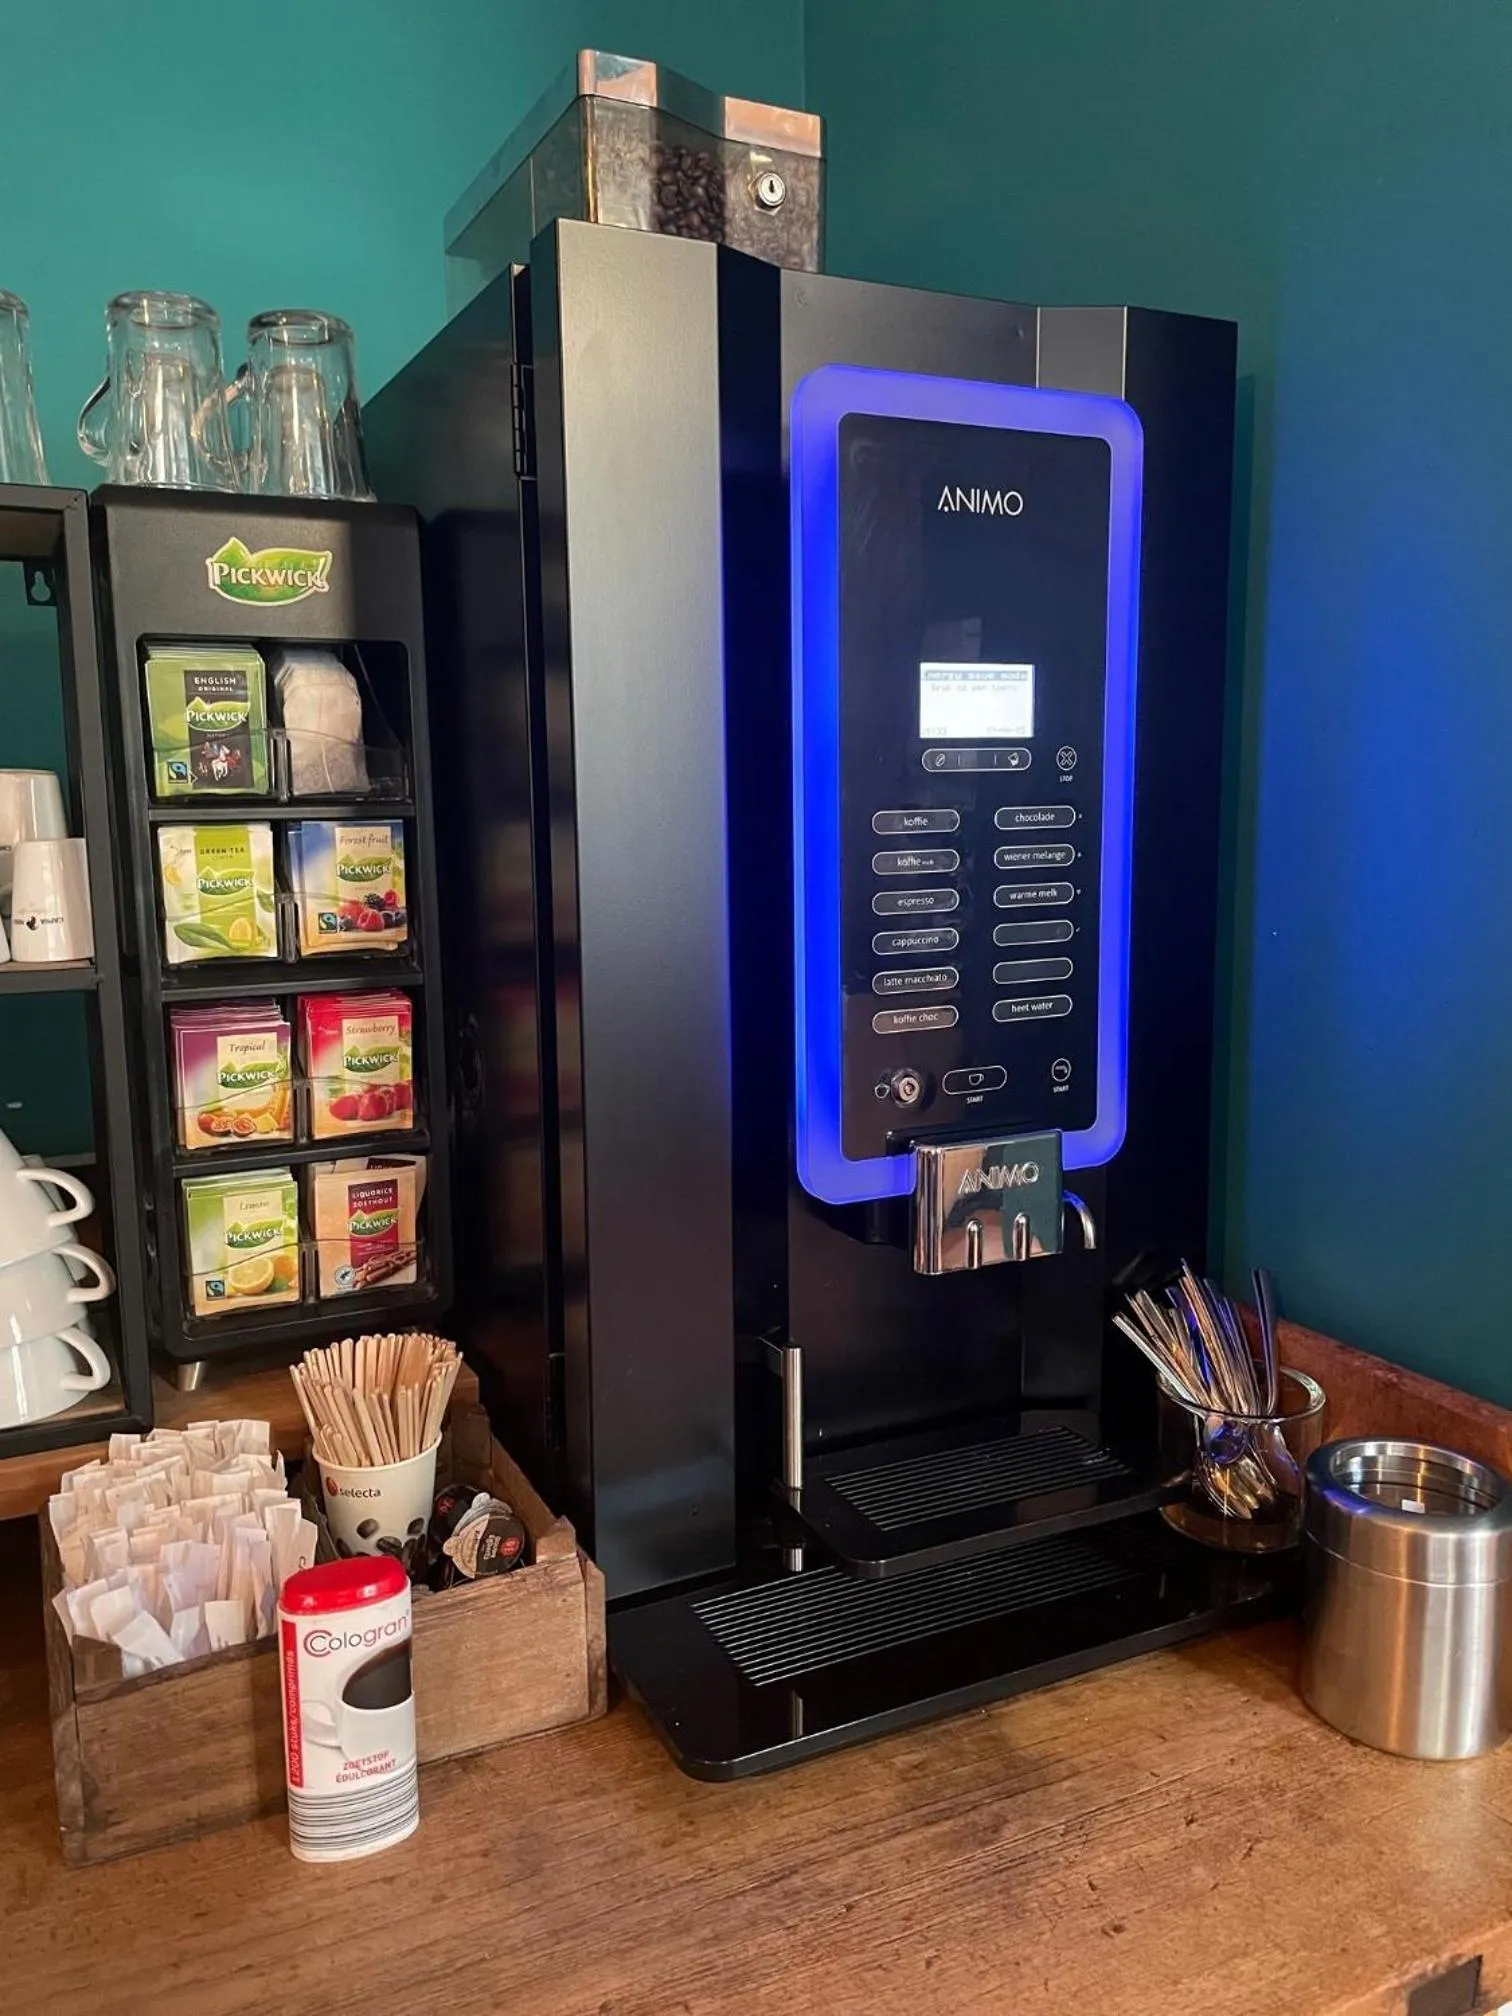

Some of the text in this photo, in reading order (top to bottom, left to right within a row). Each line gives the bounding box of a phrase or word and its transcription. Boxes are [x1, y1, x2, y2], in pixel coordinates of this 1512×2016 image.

[937, 485, 1024, 516] ANIMO
[210, 558, 327, 588] PICKWICK
[194, 677, 236, 685] ENGLISH
[186, 710, 249, 722] PICKWICK
[904, 816, 928, 827] koffie
[1015, 812, 1055, 823] chocolade
[897, 856, 921, 866] koffie
[1003, 850, 1067, 861] wiener melange
[336, 863, 391, 876] PICKWICK
[197, 877, 254, 889] PICKWICK
[1009, 888, 1058, 900] warme melk
[897, 897, 935, 907] espresso
[891, 936, 939, 948] cappuccino
[883, 973, 948, 986] latte macchiato
[1011, 1002, 1054, 1013] heet water
[893, 1012, 939, 1024] koffie choc
[346, 1023, 396, 1036] Strawberry
[229, 1040, 266, 1055] Tropical
[343, 1052, 400, 1066] PICKWICK
[217, 1070, 276, 1083] PICKWICK
[957, 1161, 1040, 1195] ANIMO
[352, 1187, 394, 1199] LIQUORICE
[240, 1201, 269, 1211] Lemon
[353, 1197, 393, 1208] ZOETHOUT
[346, 1217, 398, 1231] PICKWICK
[225, 1228, 282, 1243] PICKWICK
[339, 1487, 381, 1498] selecta
[343, 1751, 390, 1771] ZOETSTOF
[289, 1752, 302, 1783] 1200
[335, 1758, 397, 1784] ÉDULCORANT
